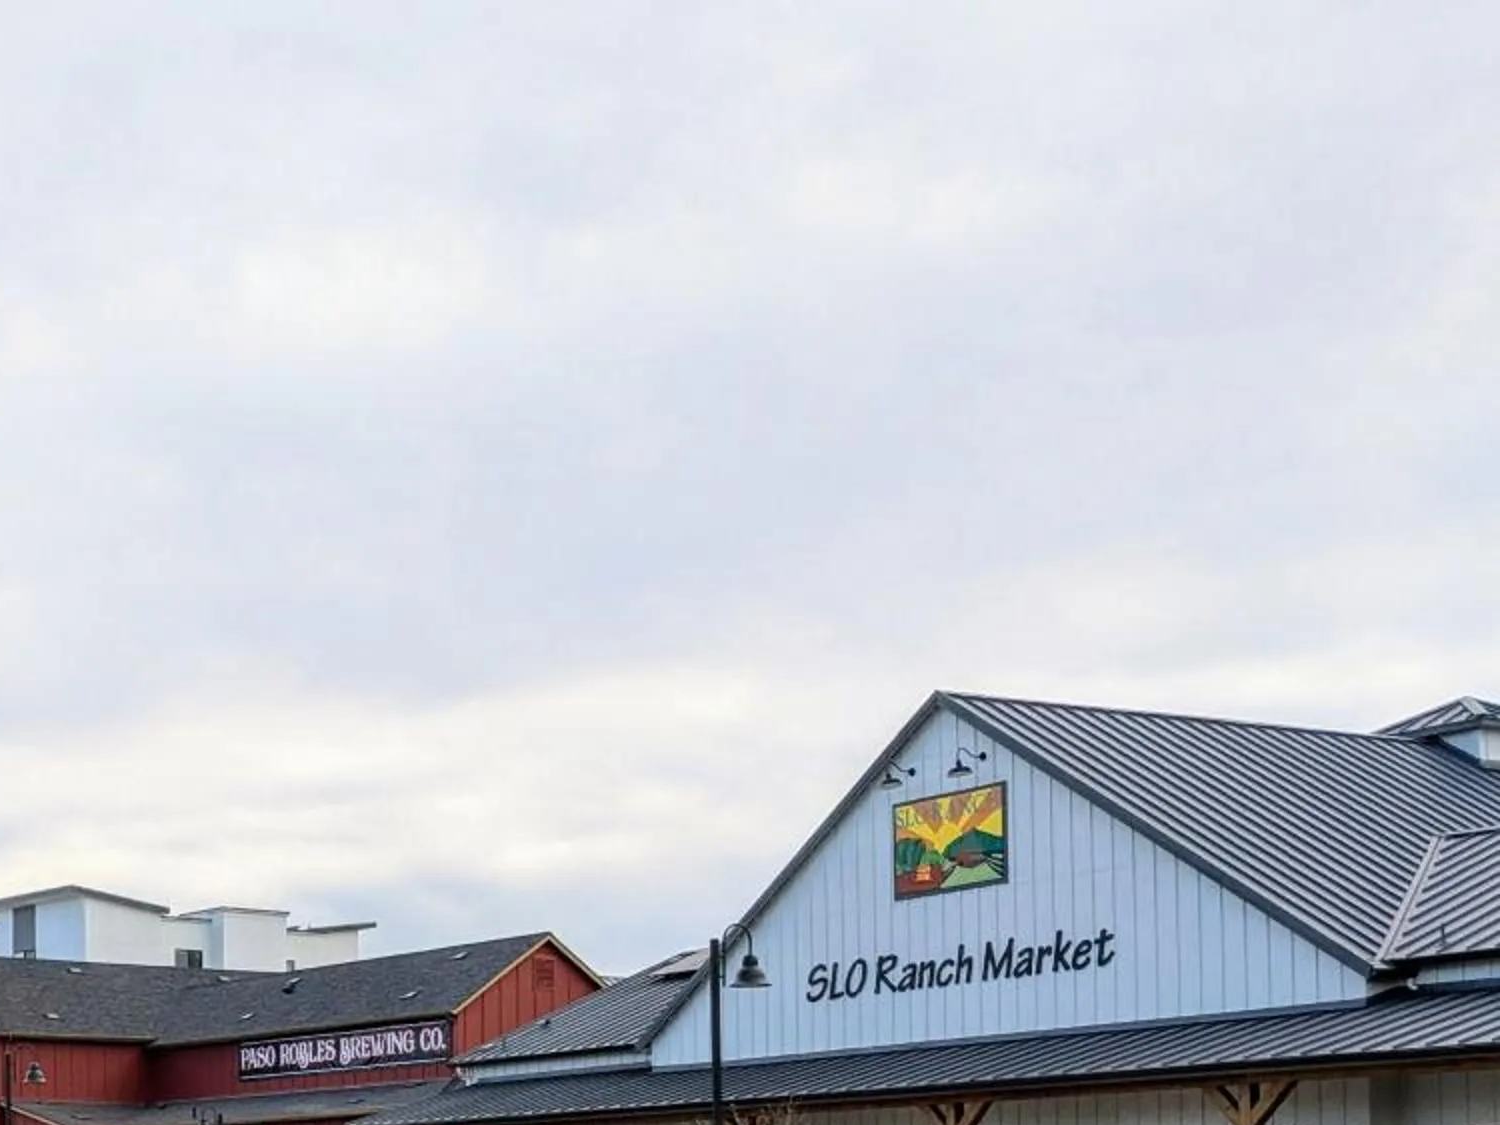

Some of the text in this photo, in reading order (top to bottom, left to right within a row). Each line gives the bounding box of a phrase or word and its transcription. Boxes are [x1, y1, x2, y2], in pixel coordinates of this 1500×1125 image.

[806, 928, 1115, 1002] SLO Ranch Market
[240, 1027, 447, 1070] PASO ROBLES BREWING CO.
